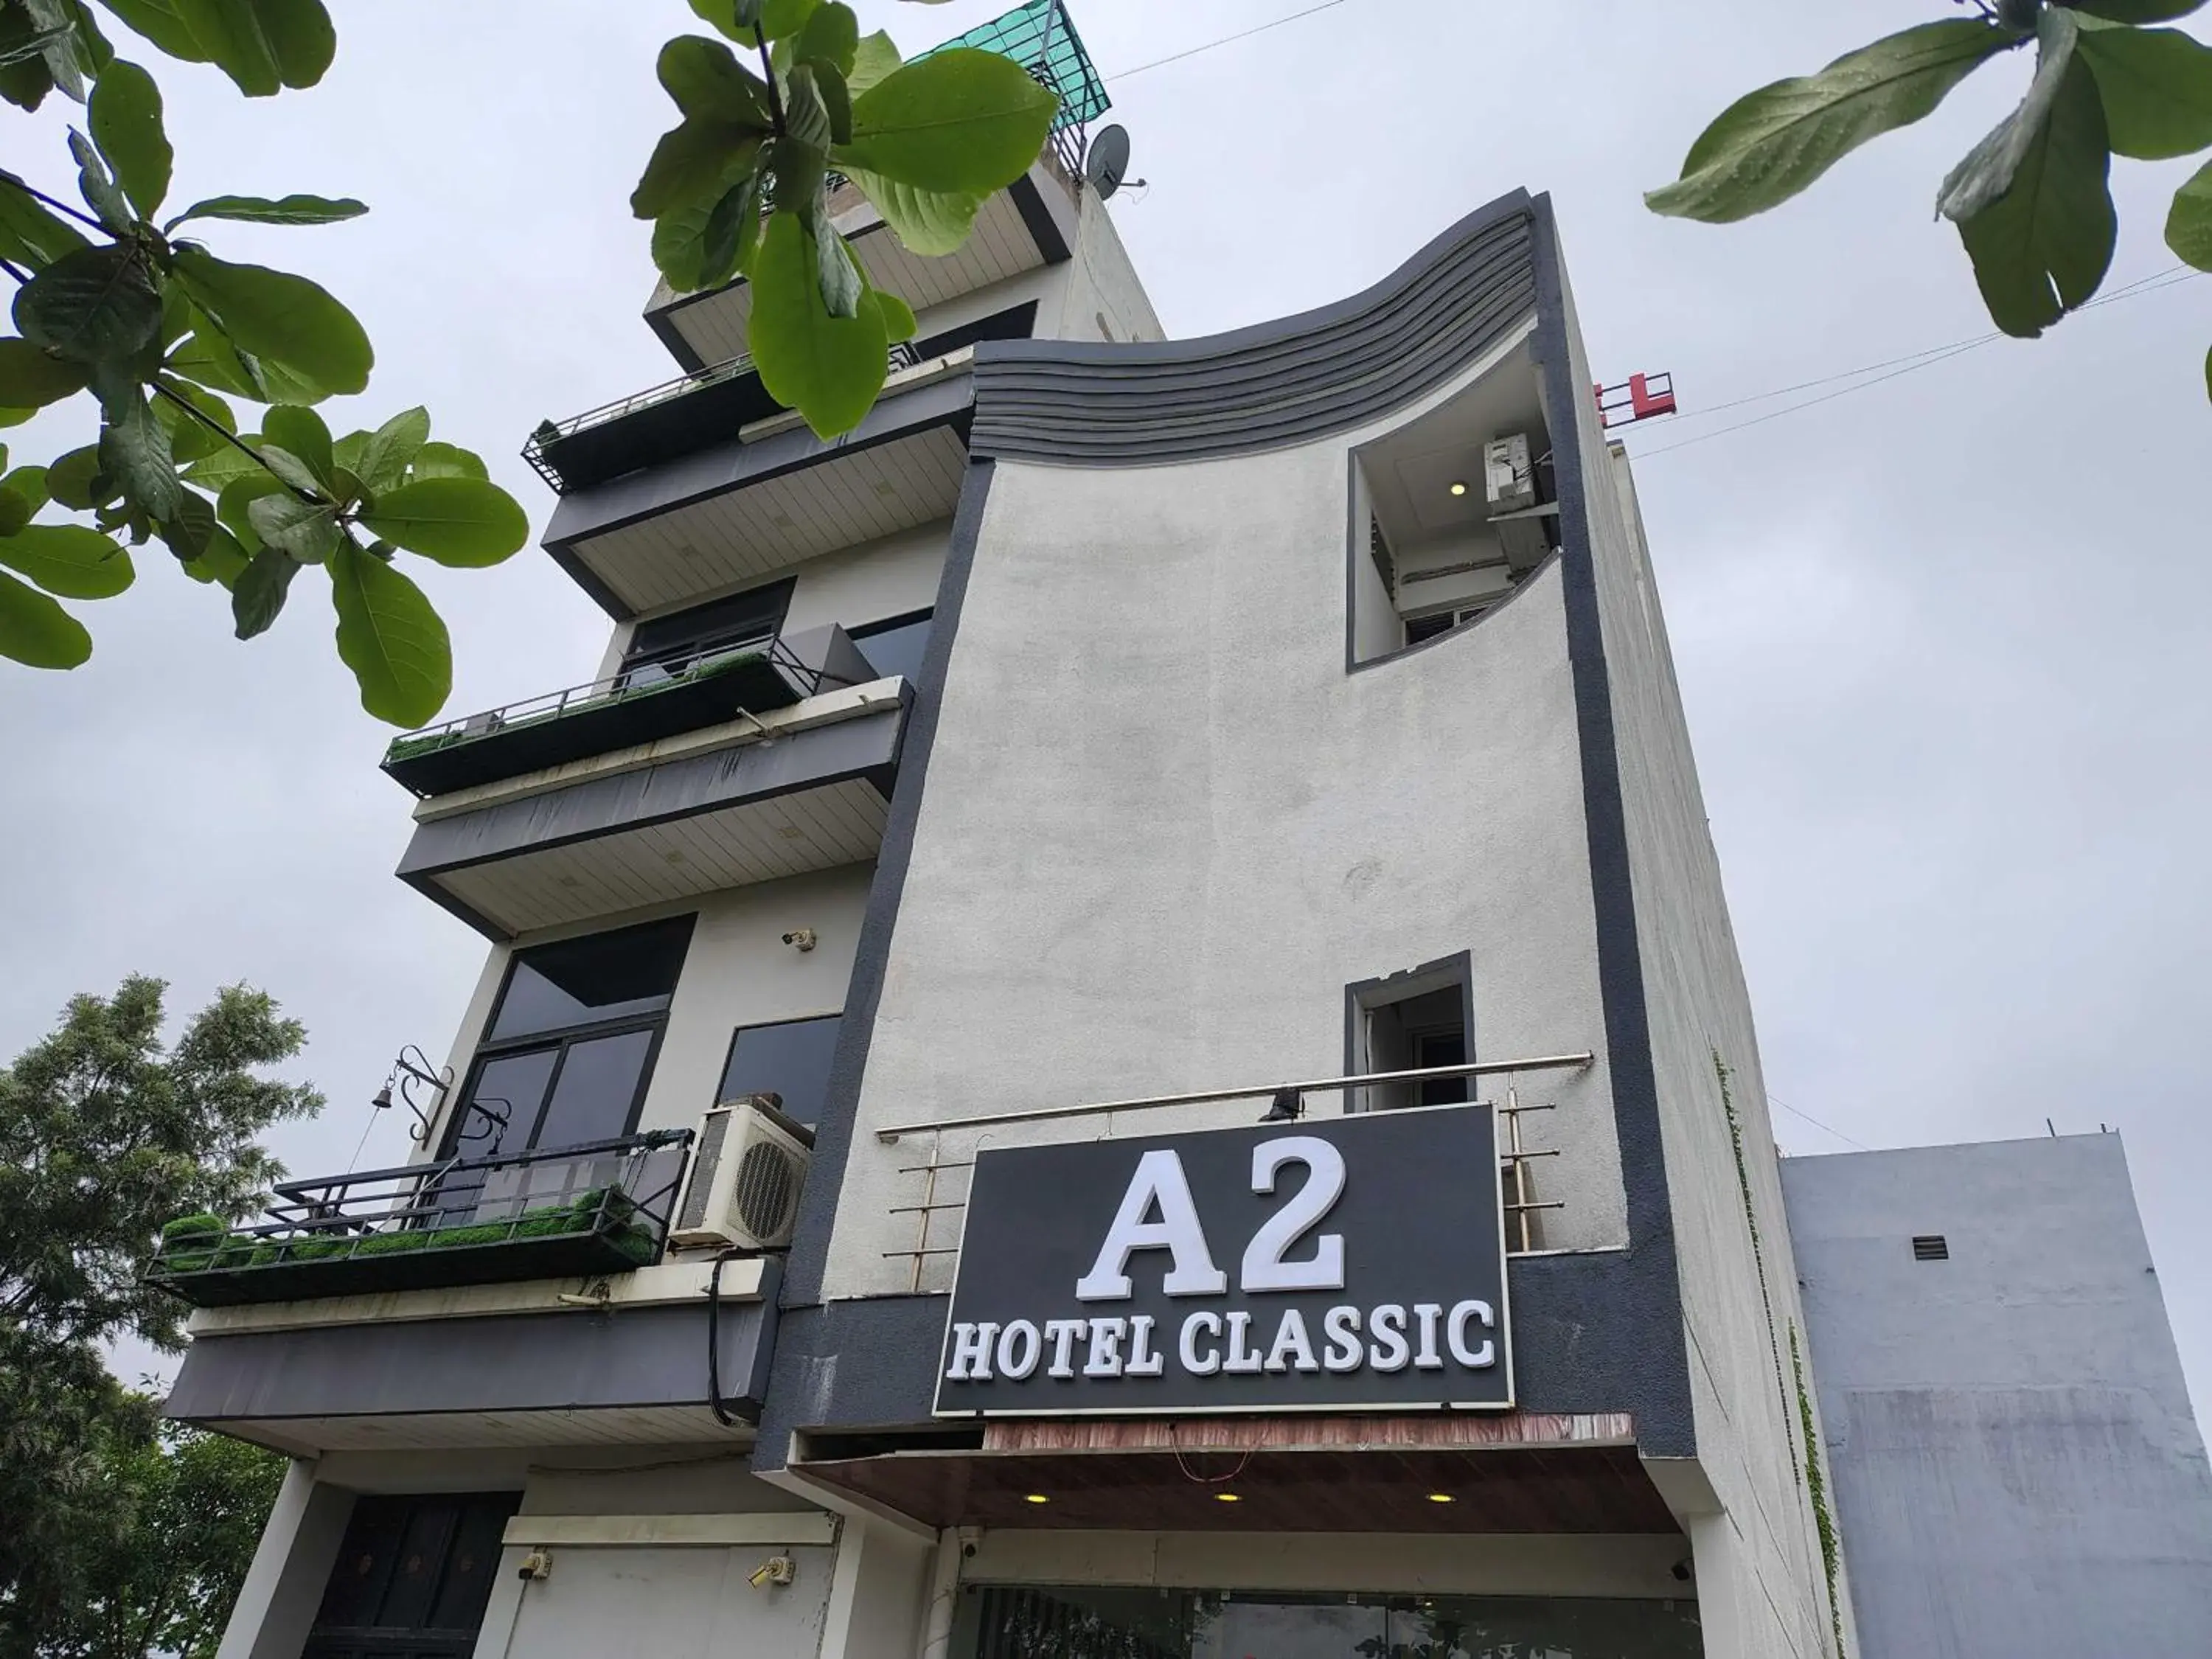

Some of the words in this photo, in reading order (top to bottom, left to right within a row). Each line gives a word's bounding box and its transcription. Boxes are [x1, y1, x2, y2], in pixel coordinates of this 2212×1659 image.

[1076, 1136, 1346, 1301] A2
[946, 1315, 1164, 1380] HOTEL
[1180, 1300, 1495, 1377] CLASSIC
